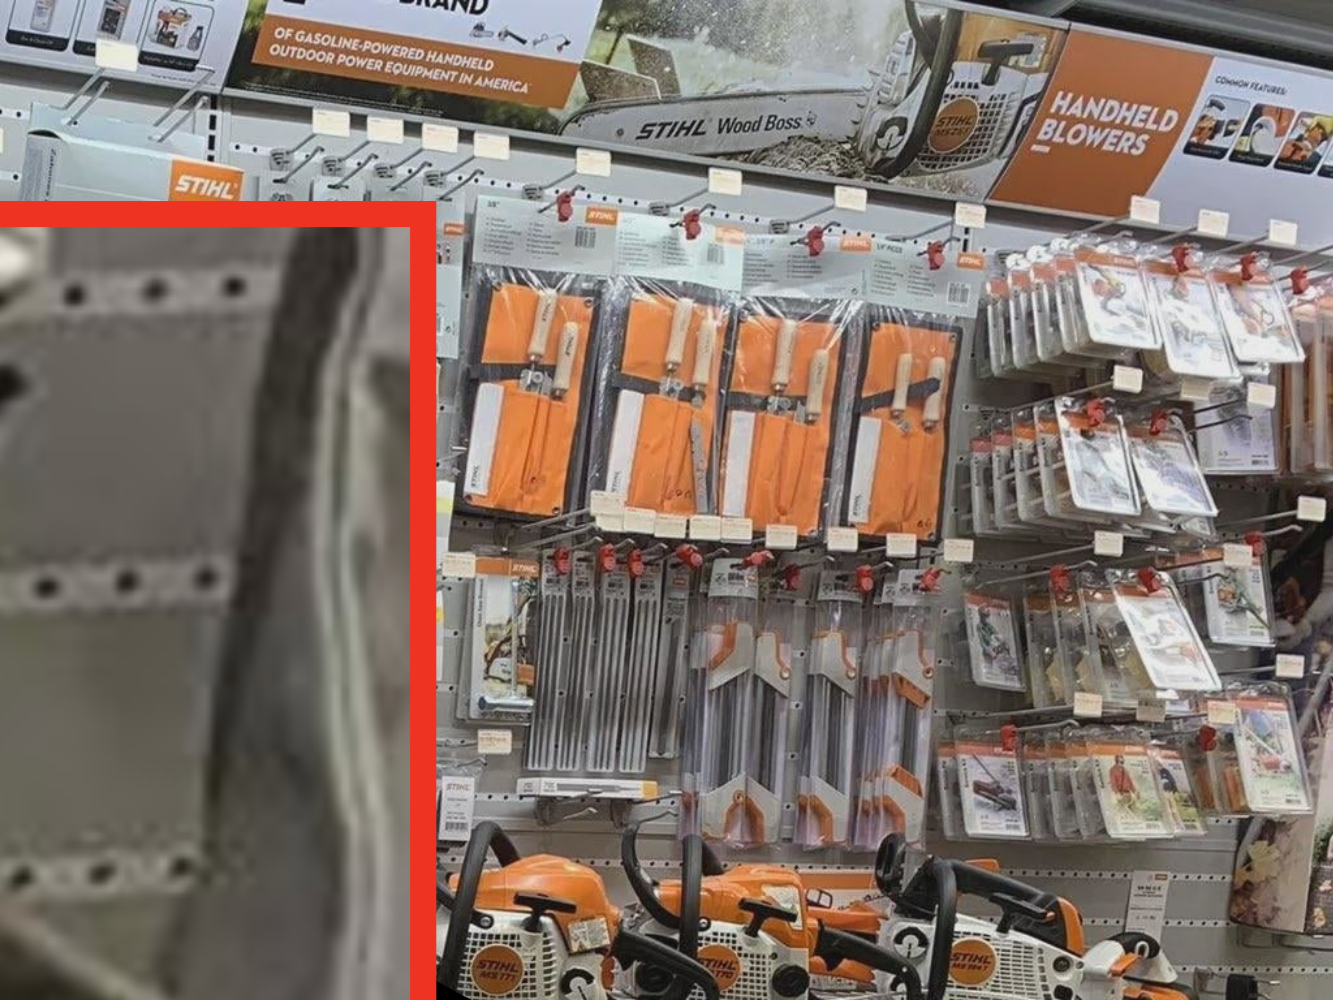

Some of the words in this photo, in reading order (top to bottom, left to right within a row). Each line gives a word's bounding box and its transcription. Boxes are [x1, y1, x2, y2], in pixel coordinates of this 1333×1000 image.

[274, 27, 293, 40] OF
[295, 29, 424, 61] GASOLINE-POWERED
[426, 50, 494, 71] HANDHELD
[269, 45, 334, 65] OUTDOOR
[336, 54, 383, 72] POWER
[384, 61, 457, 83] EQUIPMENT
[458, 72, 473, 84] IN
[474, 75, 529, 94] AMERICA
[1215, 76, 1249, 89] COMMON
[1050, 91, 1178, 132] HANDHELD
[635, 119, 707, 140] STIHL
[717, 116, 763, 134] Wood
[767, 114, 802, 131] Boss
[937, 115, 974, 127] STIHL
[1037, 119, 1150, 156] BLOWERS
[175, 174, 237, 200] STIHL
[588, 211, 616, 222] STIHL
[843, 239, 869, 250] STIHL
[959, 256, 982, 266] STIHL
[513, 563, 536, 573] STIHL
[951, 952, 991, 964] STIHL
[477, 959, 518, 973] STIHL
